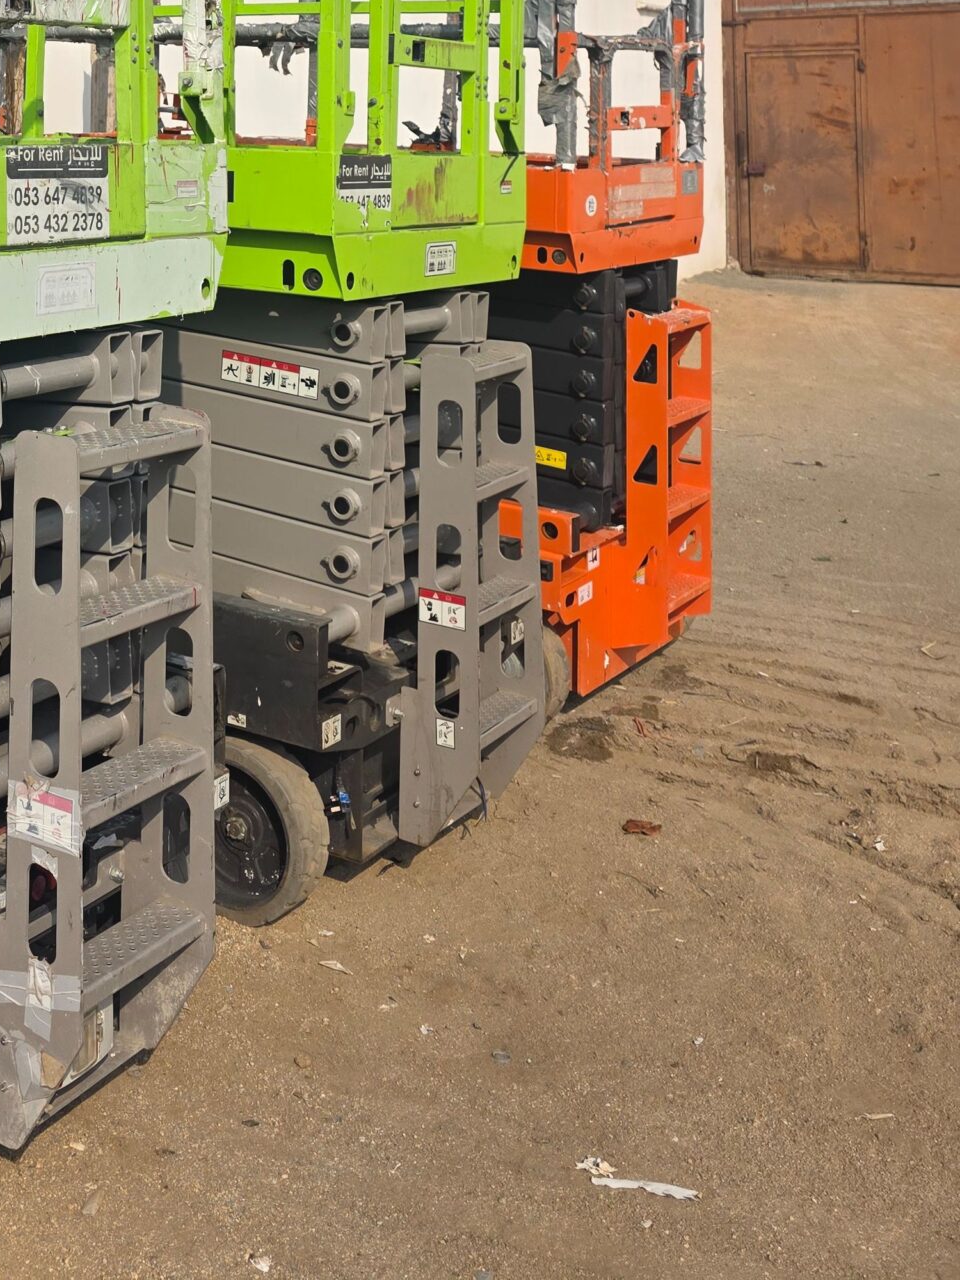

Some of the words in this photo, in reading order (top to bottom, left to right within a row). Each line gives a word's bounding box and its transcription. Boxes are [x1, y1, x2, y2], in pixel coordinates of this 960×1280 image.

[17, 146, 35, 161] For
[38, 146, 63, 161] Rent
[342, 164, 353, 177] For
[354, 164, 369, 177] Rent
[14, 187, 40, 207] 053
[44, 186, 68, 205] 647
[72, 185, 104, 205] 4839
[373, 194, 391, 209] 4839
[14, 214, 40, 235] 053
[44, 214, 68, 233] 432
[72, 212, 103, 232] 2378
